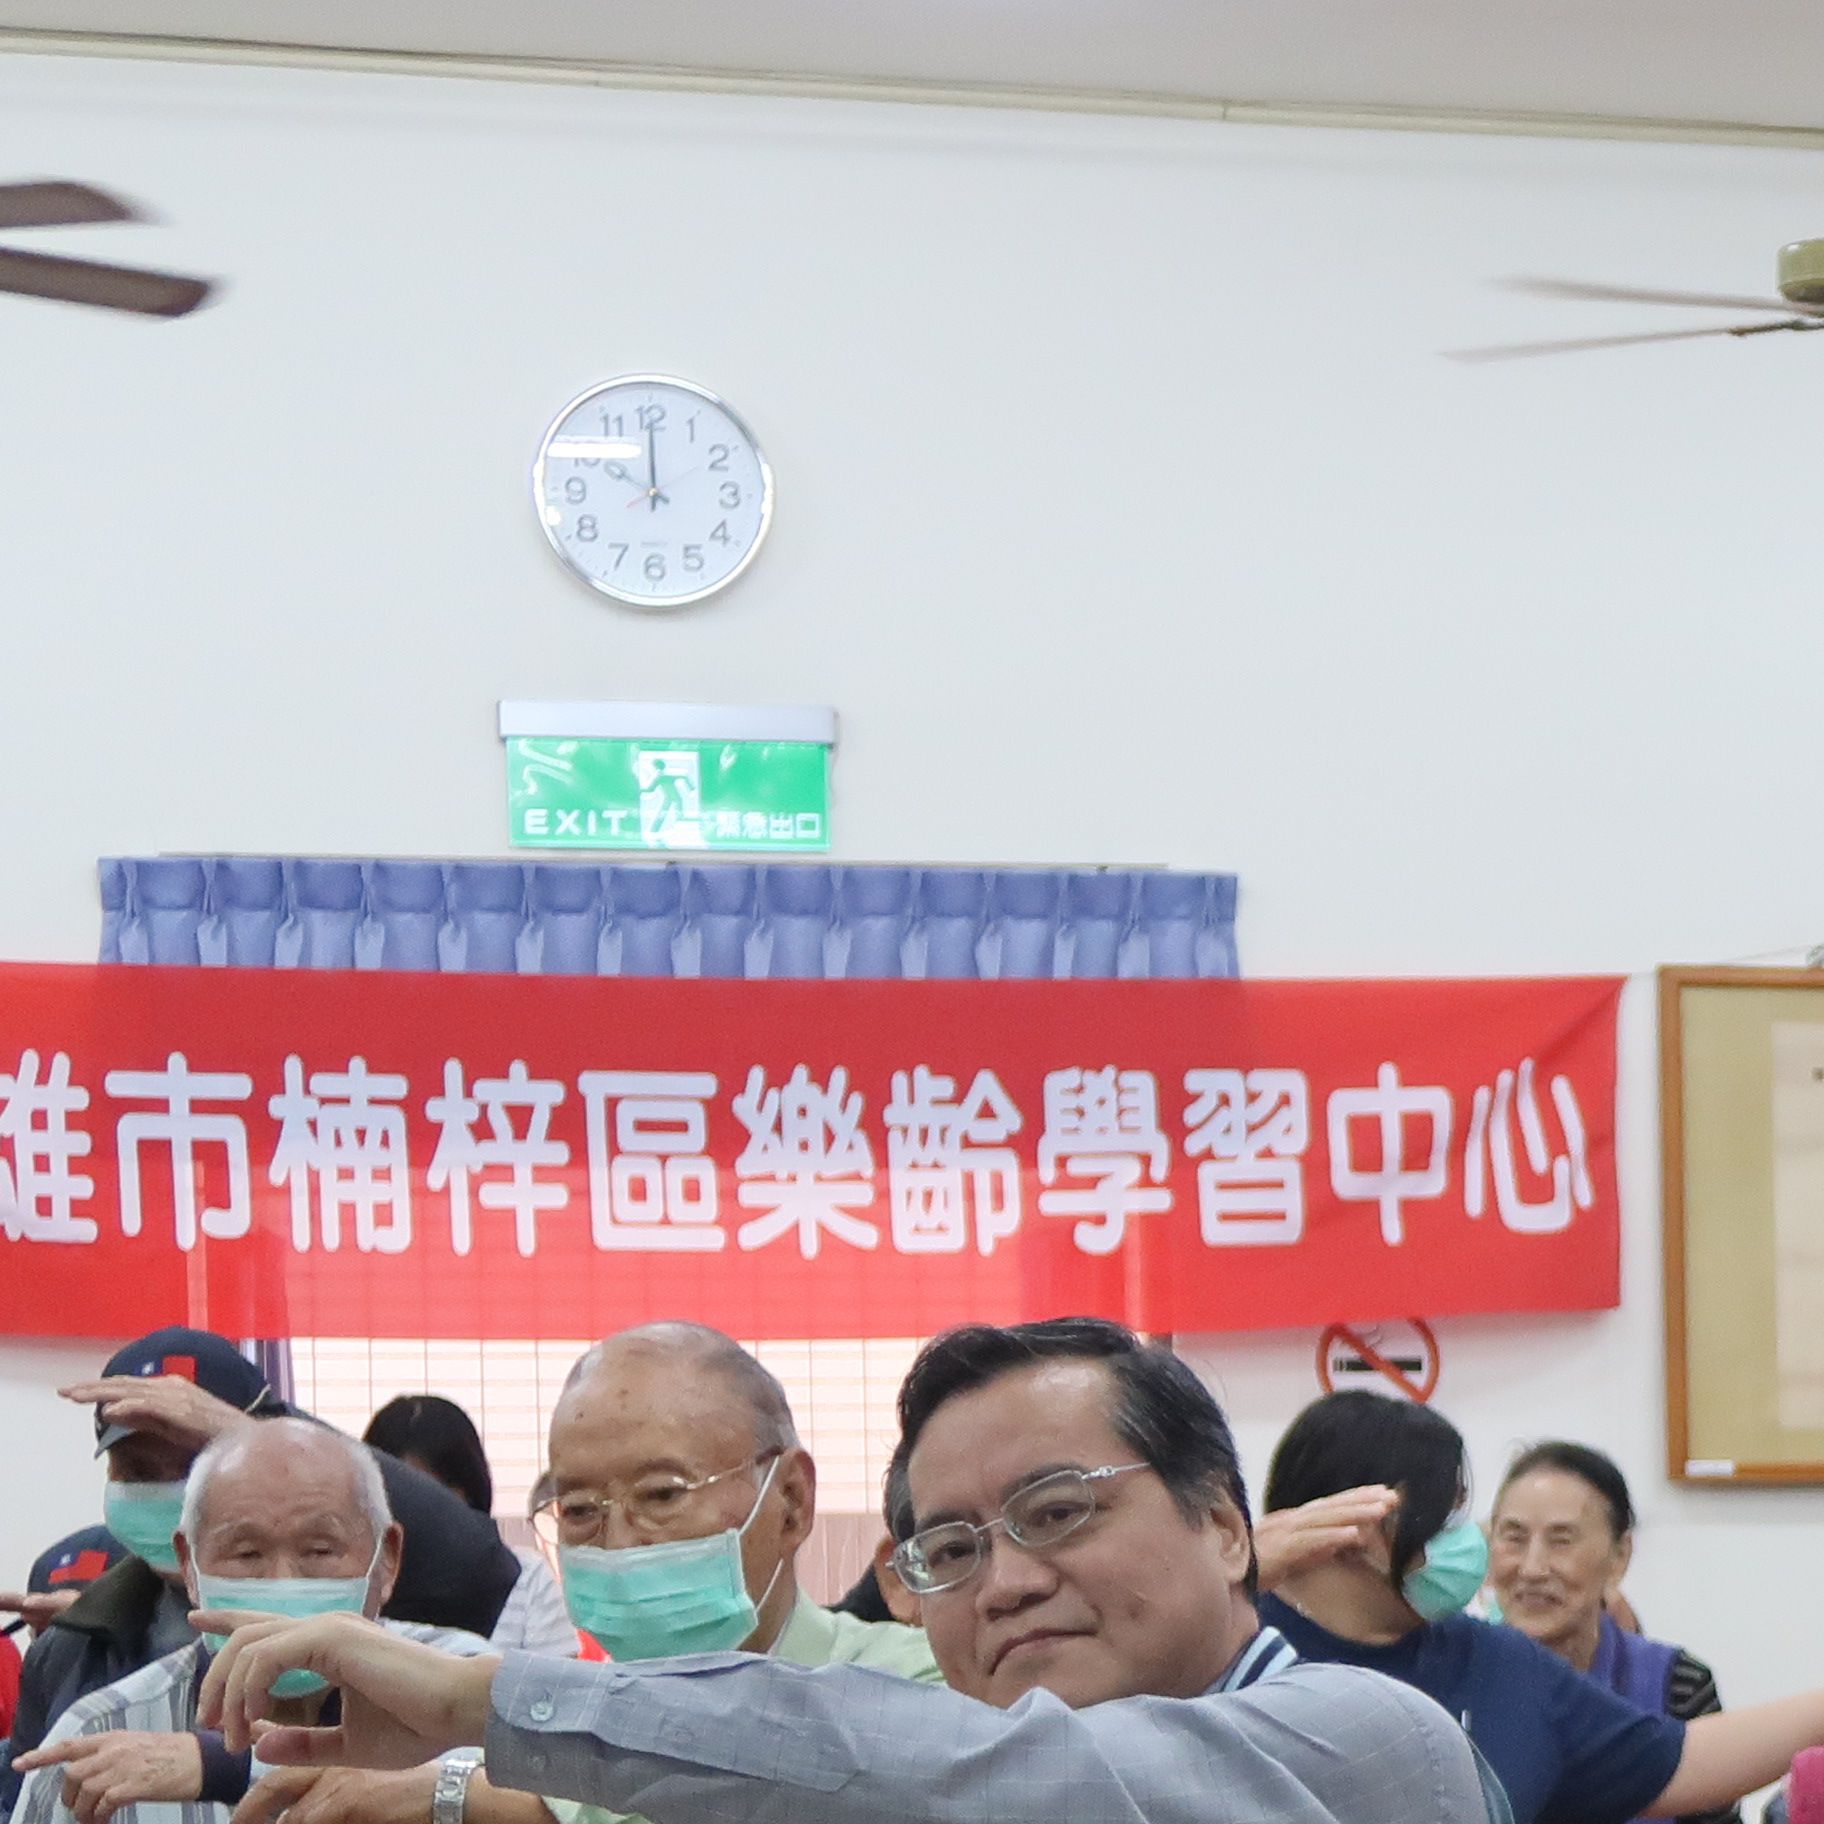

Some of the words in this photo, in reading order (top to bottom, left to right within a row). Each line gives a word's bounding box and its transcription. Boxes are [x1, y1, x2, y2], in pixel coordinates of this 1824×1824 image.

[600, 413, 624, 437] 11
[635, 404, 666, 431] 12
[686, 417, 696, 443] 1
[708, 444, 730, 472] 2
[565, 476, 587, 505] 9
[718, 481, 741, 509] 3
[576, 514, 599, 543] 8
[709, 519, 731, 546] 4
[608, 543, 630, 571] 7
[644, 553, 666, 581] 6
[682, 544, 705, 572] 5
[523, 808, 628, 836] EXIT
[715, 811, 821, 839] 緊急出口
